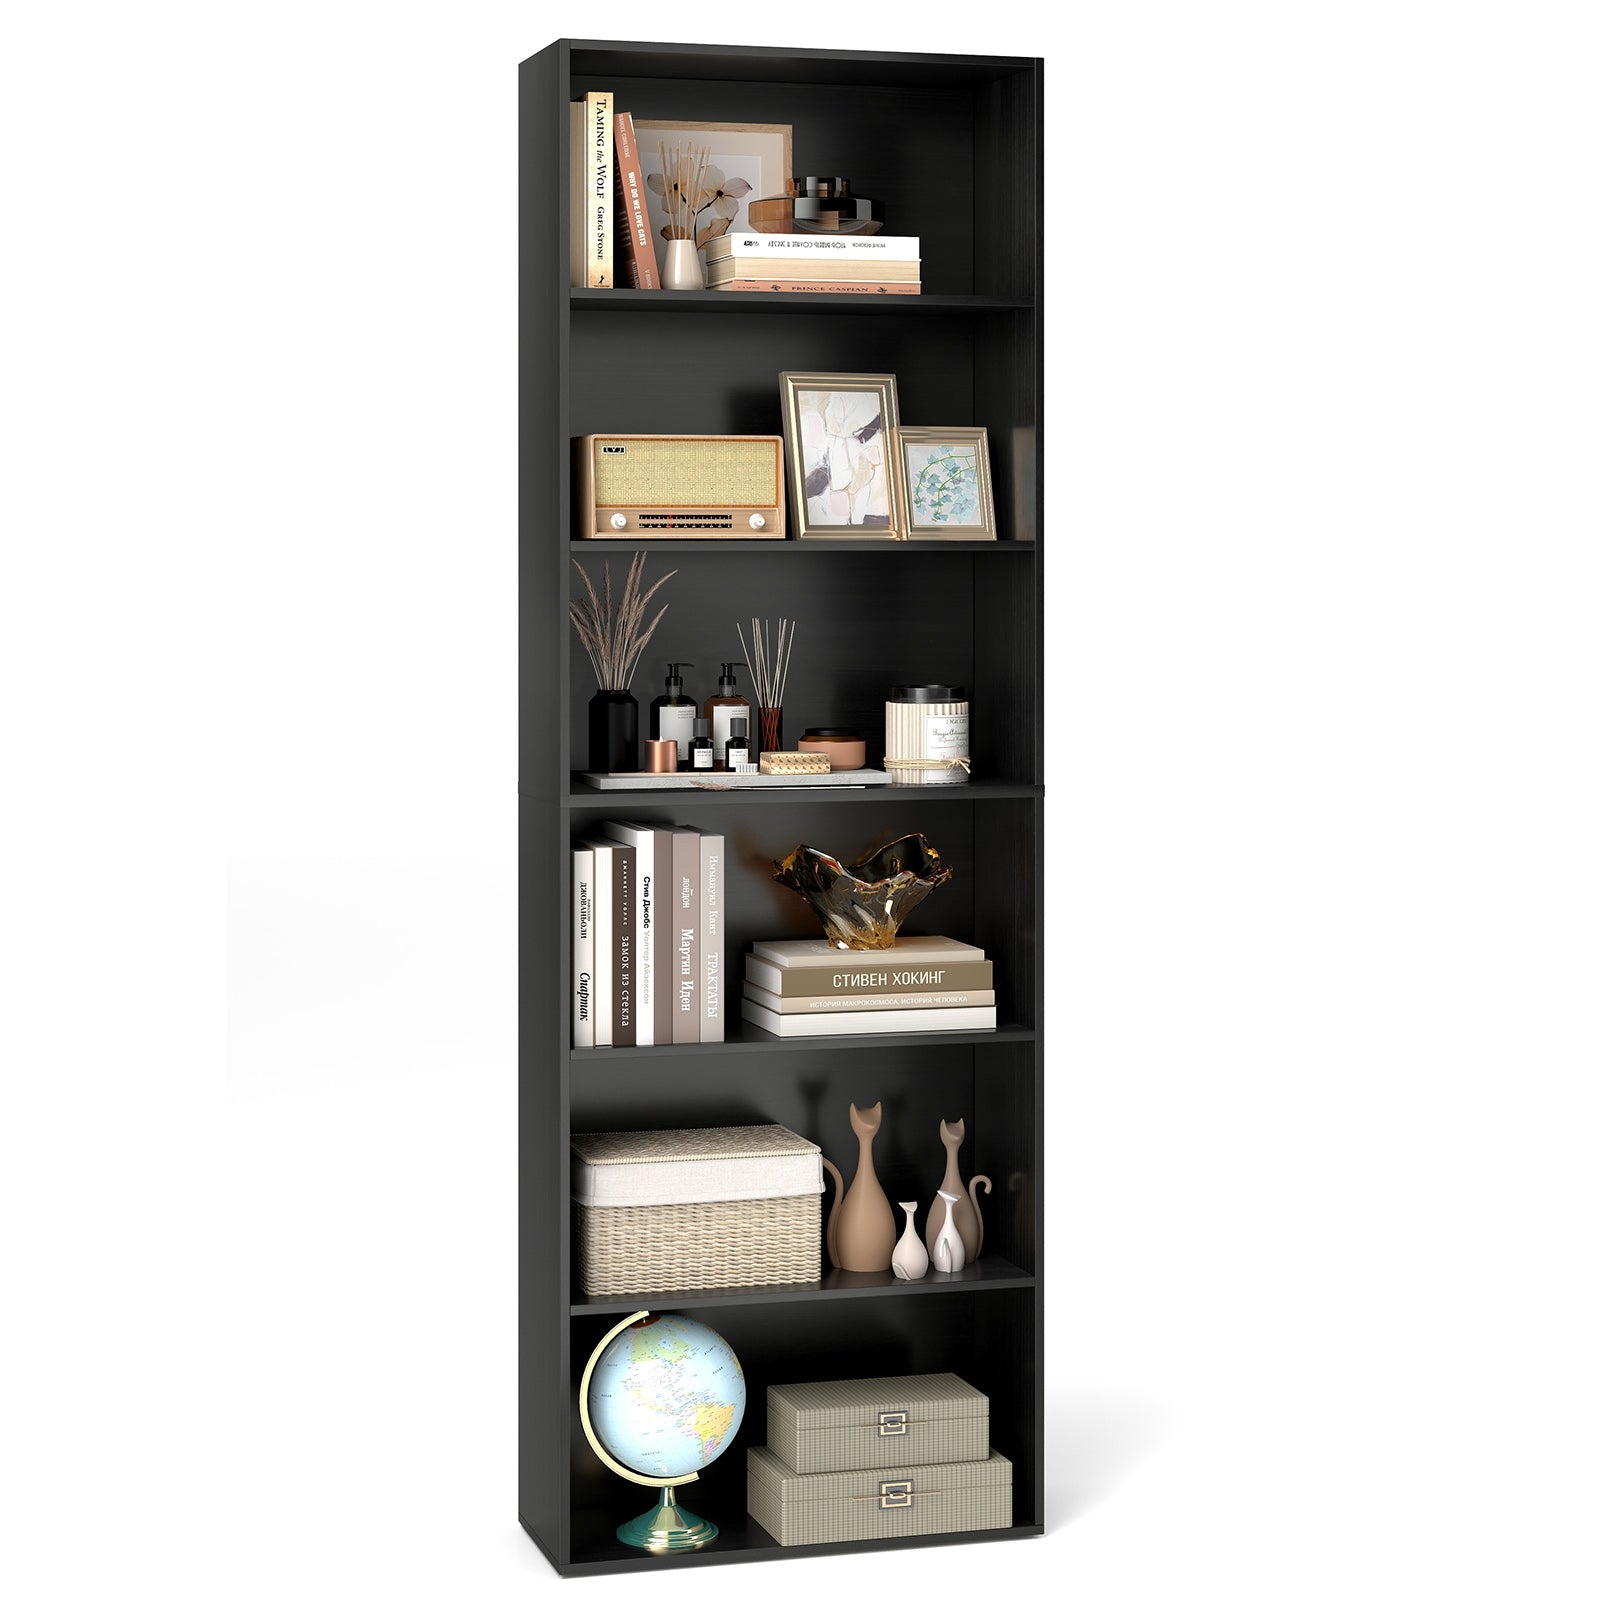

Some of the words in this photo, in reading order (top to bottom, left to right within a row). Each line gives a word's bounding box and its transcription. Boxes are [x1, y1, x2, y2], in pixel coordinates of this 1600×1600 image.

[596, 99, 607, 147] TAMING
[596, 150, 605, 163] the
[596, 164, 607, 199] WOLF
[627, 172, 637, 187] WHY
[630, 189, 639, 198] DO
[596, 206, 605, 231] GREG
[632, 199, 641, 211] WE
[634, 211, 644, 228] LOVE
[597, 233, 605, 260] STONE
[637, 229, 647, 246] CATS
[643, 876, 651, 898] Стив
[708, 855, 718, 906] Иммануил
[580, 881, 588, 939] ДЖОВАНЬОЛИ
[642, 899, 651, 929] Джобс
[709, 910, 718, 936] Кант
[621, 936, 630, 969] замок
[642, 931, 650, 961] Уолтер
[679, 928, 694, 975] Мартин
[621, 973, 630, 986] из
[643, 963, 651, 1005] Айзексон
[707, 952, 718, 1018] ТРАКТАТЫ
[833, 972, 888, 988] СТИВЕН
[892, 970, 946, 985] ХОКИНГ
[577, 972, 591, 1022] Спартак
[621, 990, 630, 1027] стекла
[679, 980, 694, 1011] Иден
[810, 1001, 842, 1009] ИСТОРИЯ
[901, 998, 933, 1006] ИСТОРИЯ
[933, 996, 968, 1004] ЧЕЛОВЕКА
